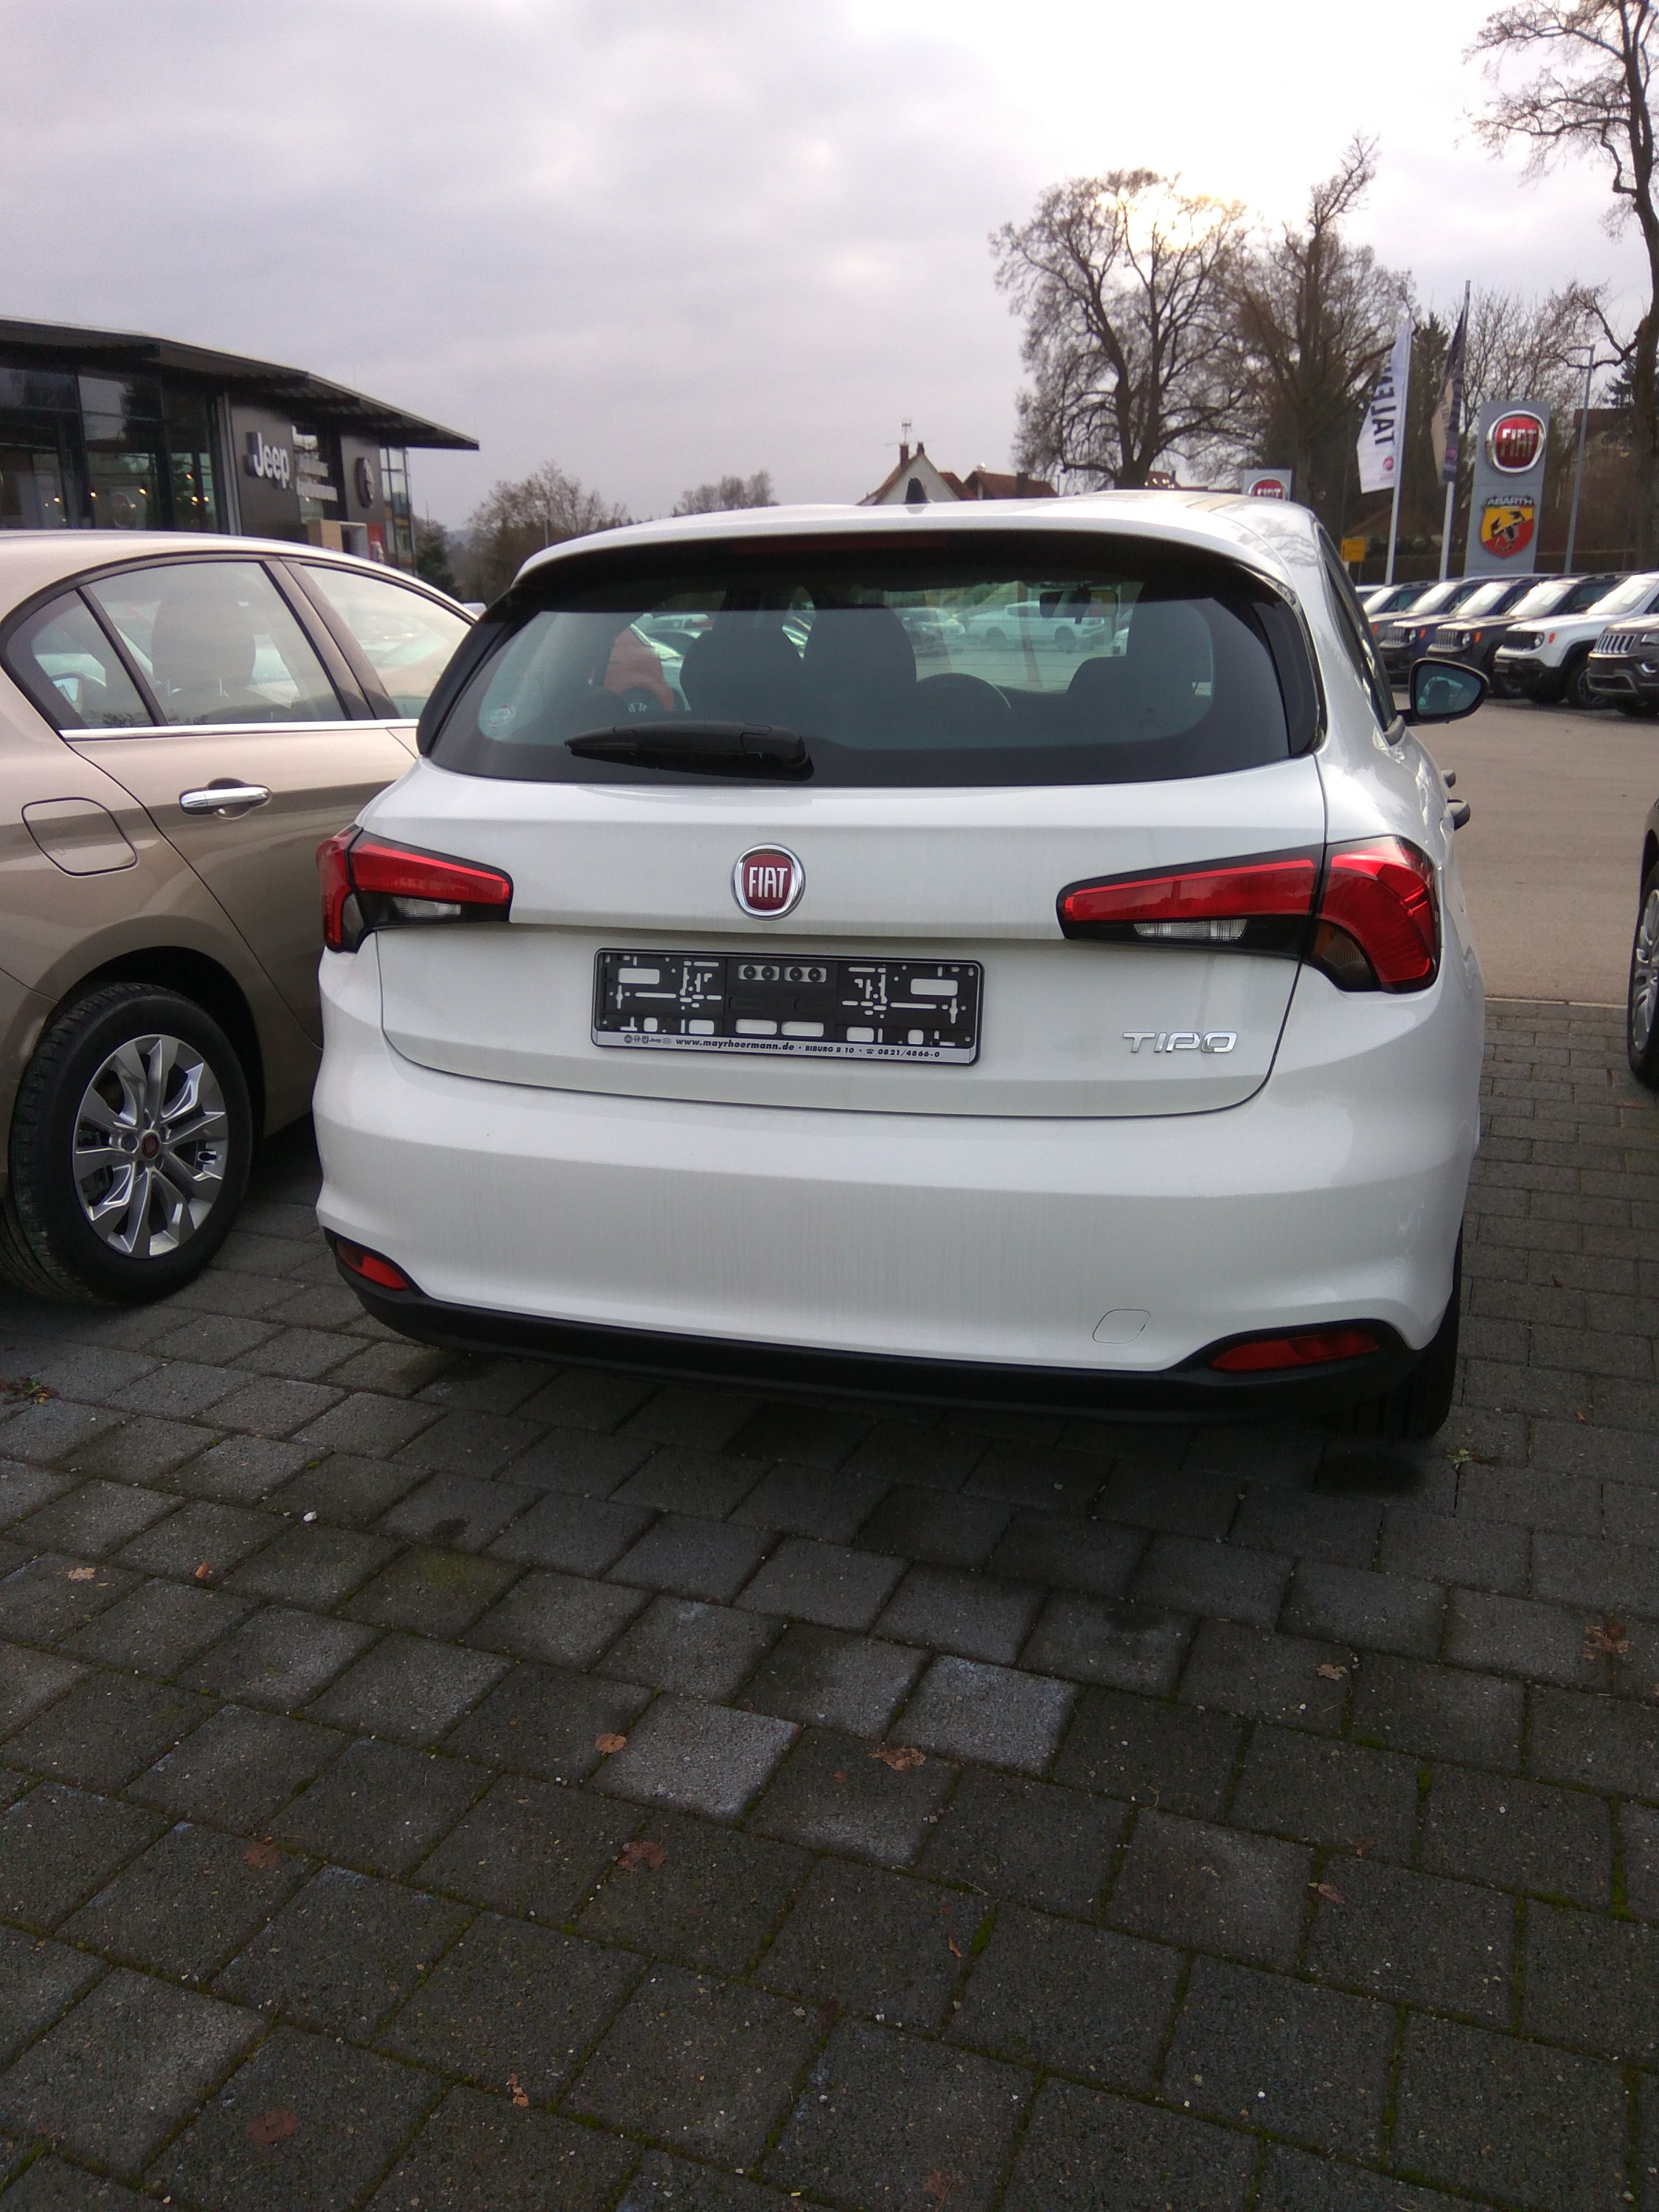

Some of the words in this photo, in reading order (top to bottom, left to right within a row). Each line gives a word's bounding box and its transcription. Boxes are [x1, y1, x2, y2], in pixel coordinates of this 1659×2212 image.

[1500, 428, 1537, 457] FIAT
[253, 432, 291, 490] Jeep
[1486, 497, 1533, 506] ABARTH
[748, 866, 788, 899] FIAT
[675, 1037, 795, 1051] www.mayrhoermann.de
[804, 1045, 834, 1053] BIBURG
[877, 1048, 940, 1057] 0821/4866-0
[1122, 1032, 1238, 1053] TIPO
